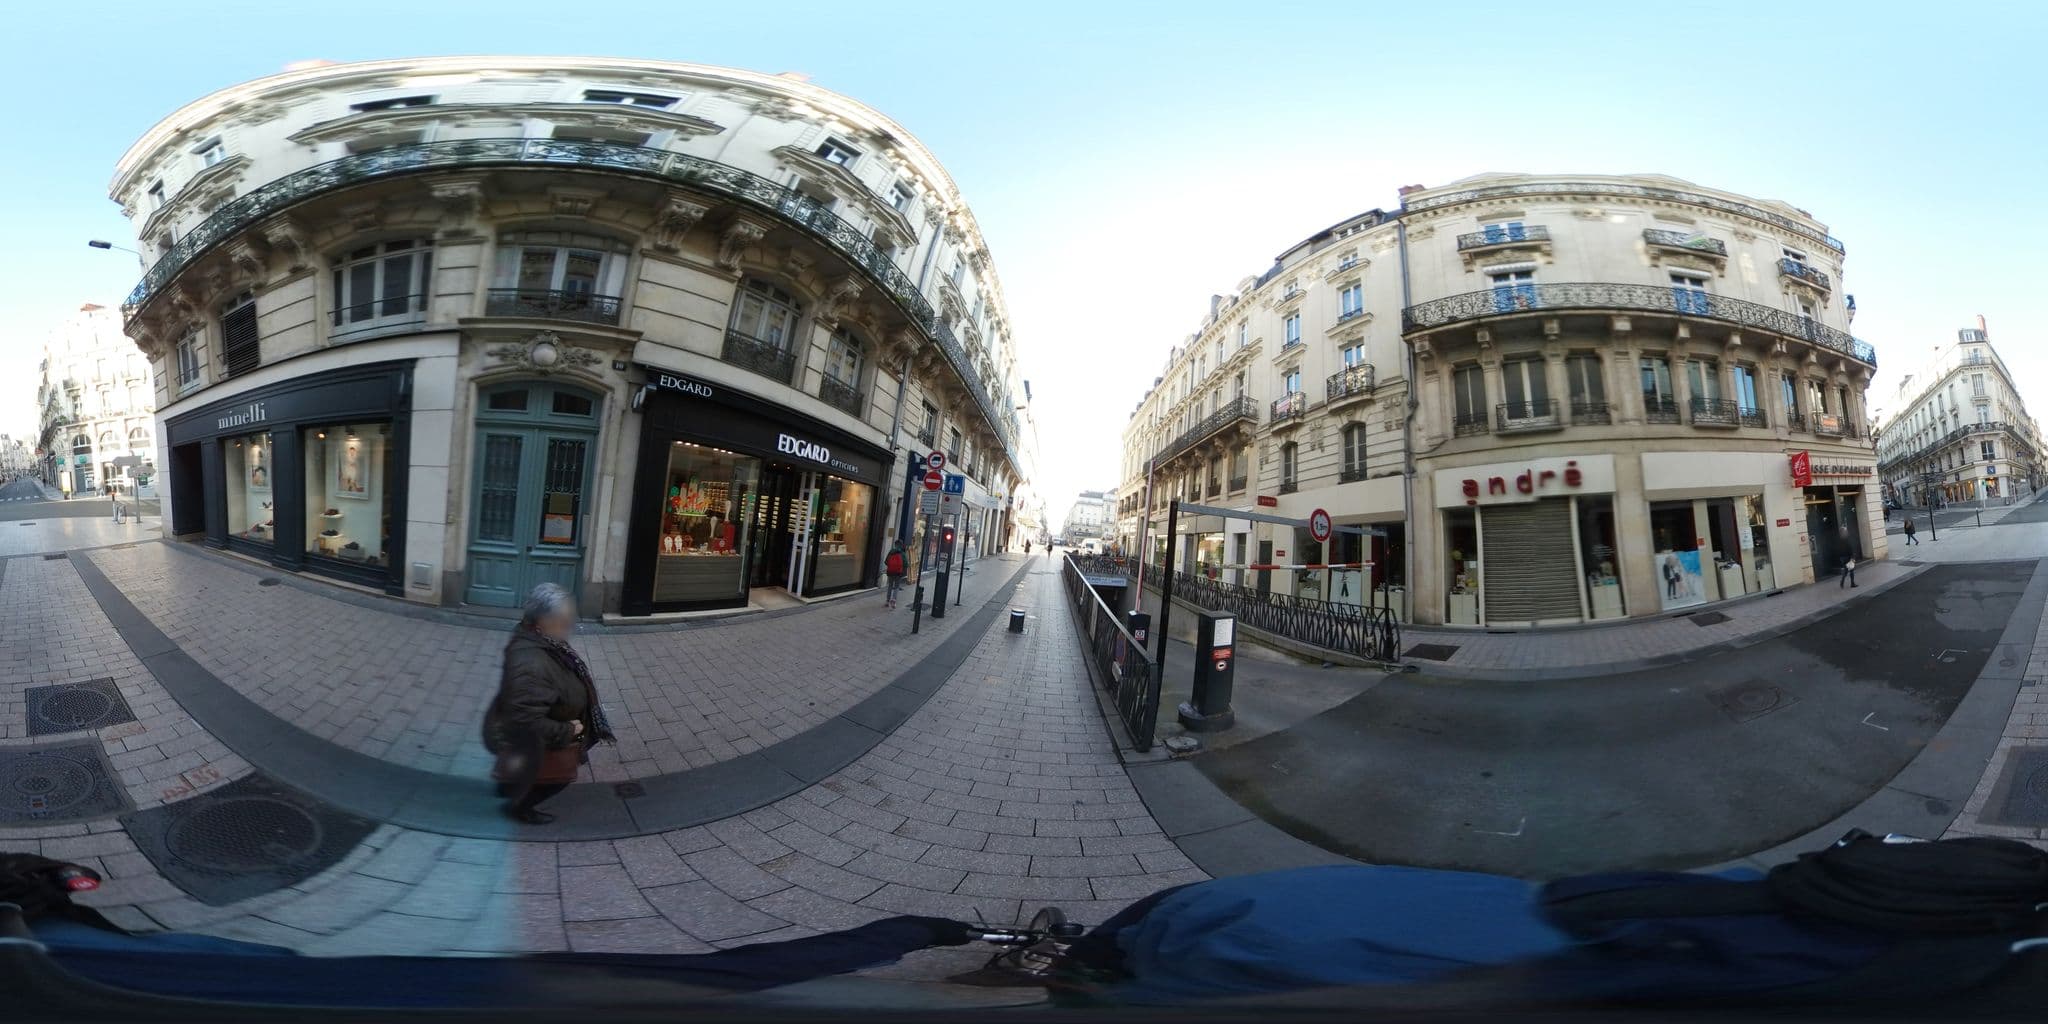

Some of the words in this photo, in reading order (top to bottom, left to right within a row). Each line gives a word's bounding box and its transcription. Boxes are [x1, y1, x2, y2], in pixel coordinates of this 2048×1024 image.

[660, 375, 713, 397] EDGARD
[218, 402, 266, 429] minelli
[777, 433, 830, 463] EDGARD
[831, 459, 859, 473] OPTICIENS
[1811, 464, 1830, 474] ISSE
